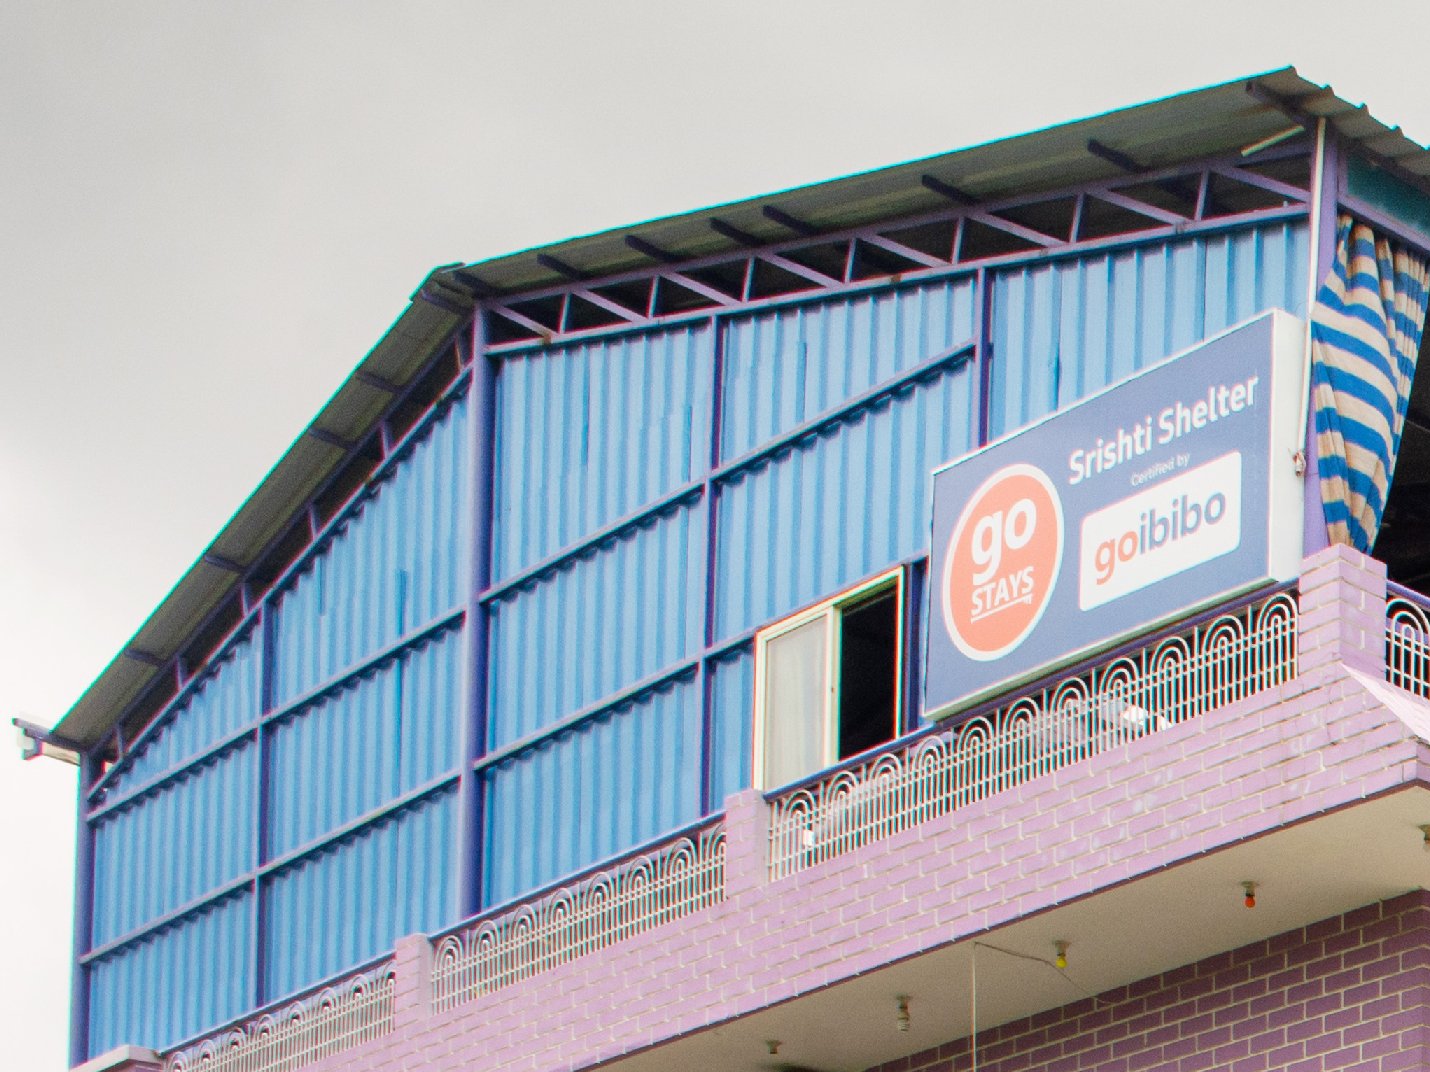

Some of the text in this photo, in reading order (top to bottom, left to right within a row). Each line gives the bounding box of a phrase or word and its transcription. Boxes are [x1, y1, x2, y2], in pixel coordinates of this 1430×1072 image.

[1068, 376, 1259, 485] Srishti Shelter
[1131, 452, 1190, 486] Certified by
[971, 498, 1036, 586] go
[1095, 491, 1226, 585] goibibo
[970, 565, 1034, 616] STAYS
